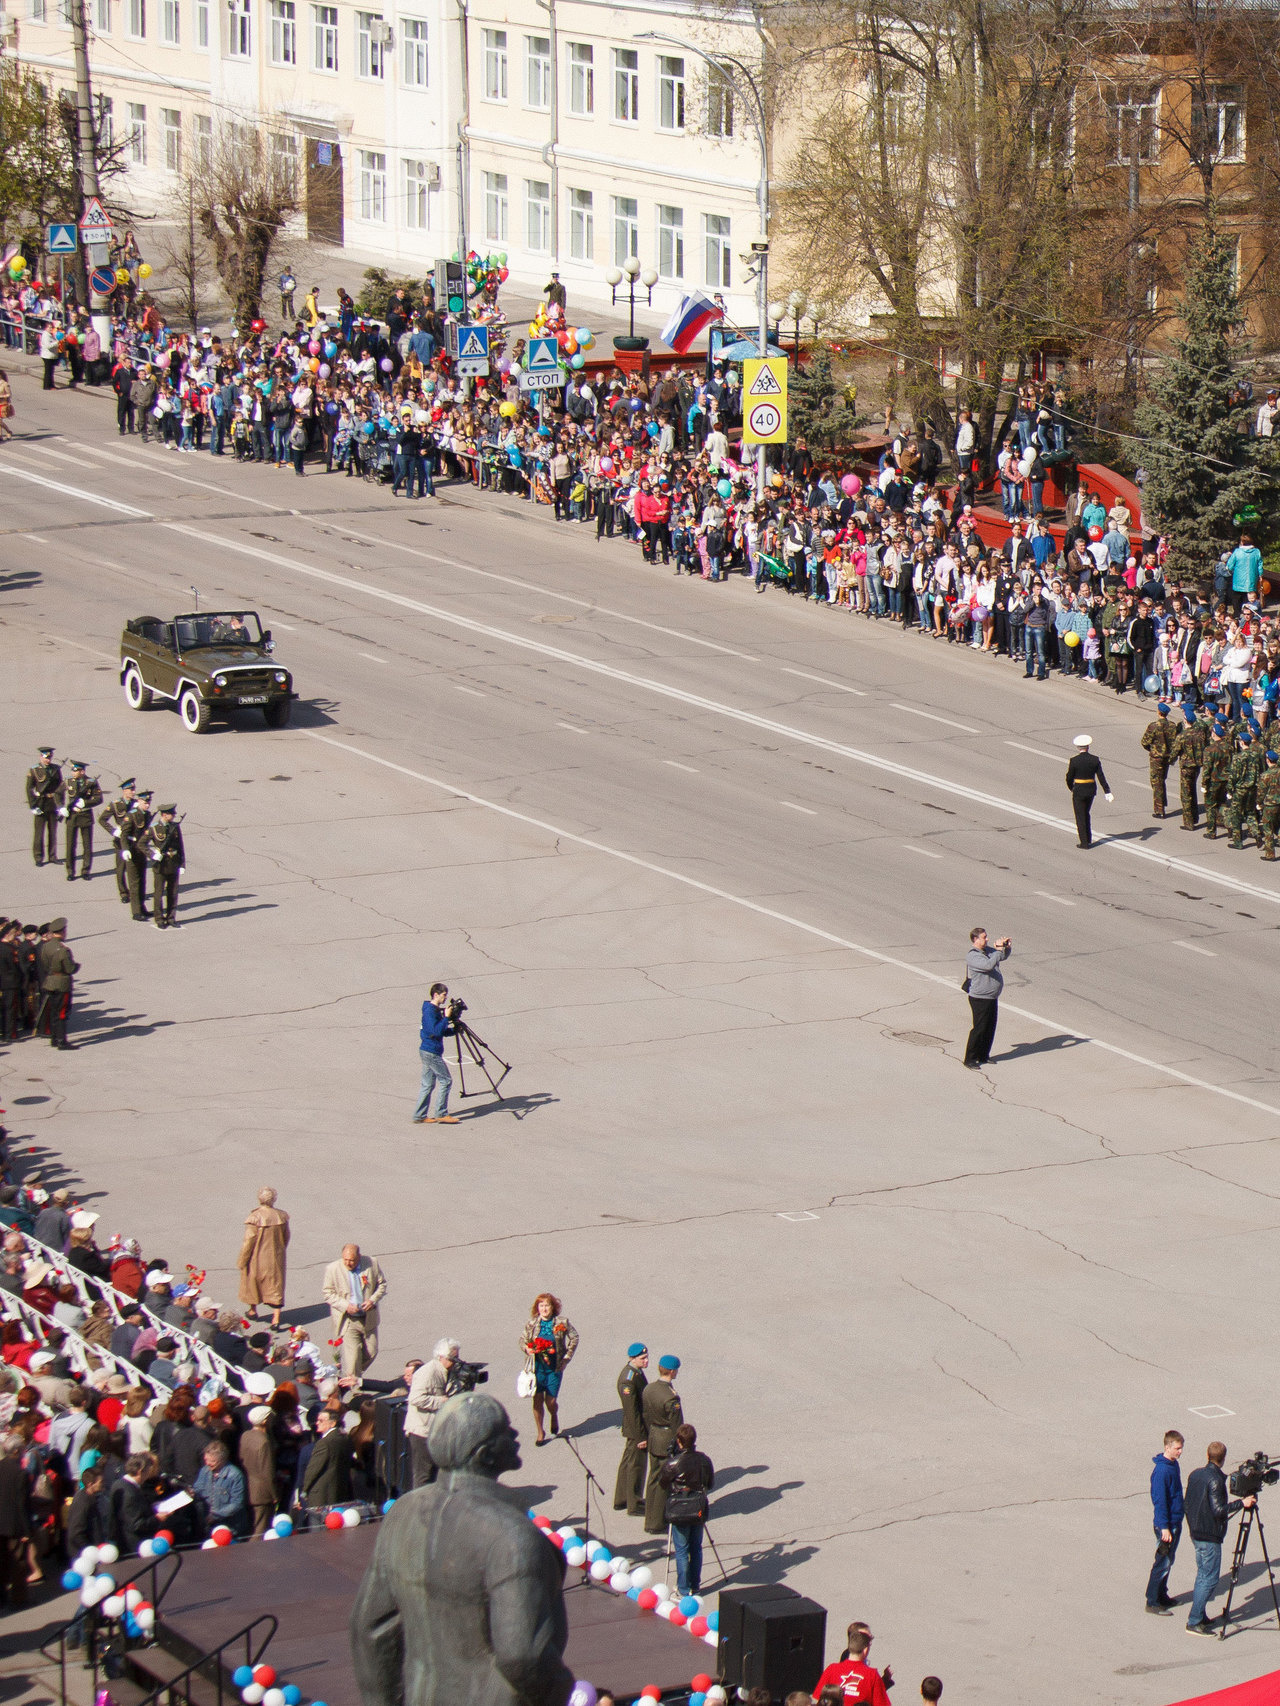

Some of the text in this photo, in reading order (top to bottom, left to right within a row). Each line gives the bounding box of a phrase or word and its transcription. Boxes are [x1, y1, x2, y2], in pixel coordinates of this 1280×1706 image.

[447, 280, 462, 294] 20
[527, 373, 559, 387] СТОП
[756, 413, 774, 426] 40
